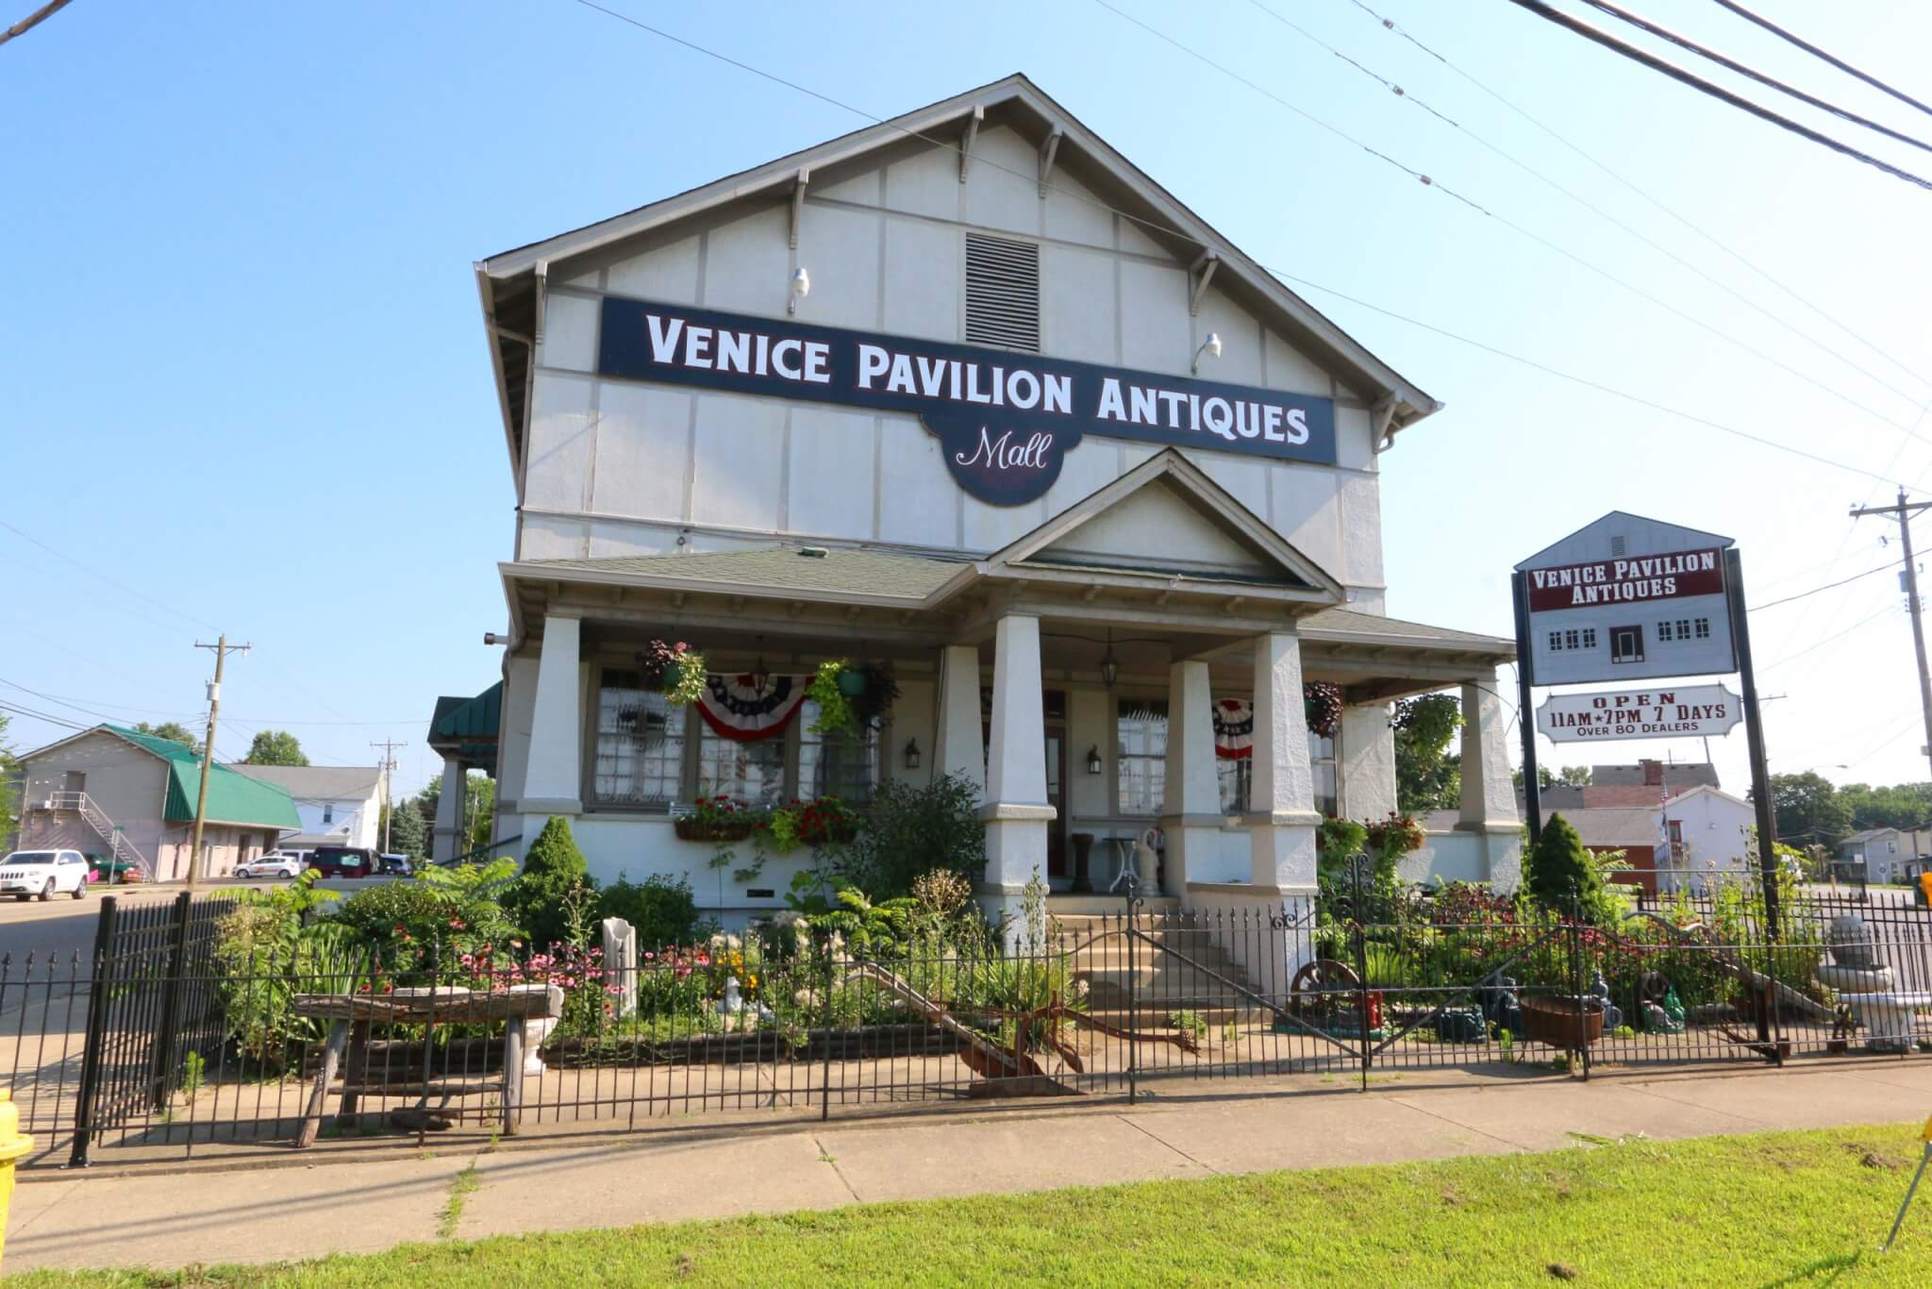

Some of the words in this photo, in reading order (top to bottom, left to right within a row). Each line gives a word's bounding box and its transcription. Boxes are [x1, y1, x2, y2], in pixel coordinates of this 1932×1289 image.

[646, 315, 831, 383] VENICE
[858, 344, 1072, 414] PAVILION
[1097, 378, 1309, 444] ANTIQUES
[956, 425, 1052, 469] Mall
[1533, 565, 1606, 589] VENICE
[1614, 552, 1715, 580] PAVILION
[1571, 577, 1676, 604] ANTIQUES
[1593, 693, 1675, 708] OPEN
[1654, 706, 1663, 722] 7
[1677, 704, 1726, 720] DAYS
[1577, 726, 1609, 737] OVER
[1615, 724, 1636, 735] 80
[1642, 722, 1699, 733] DEALERS
